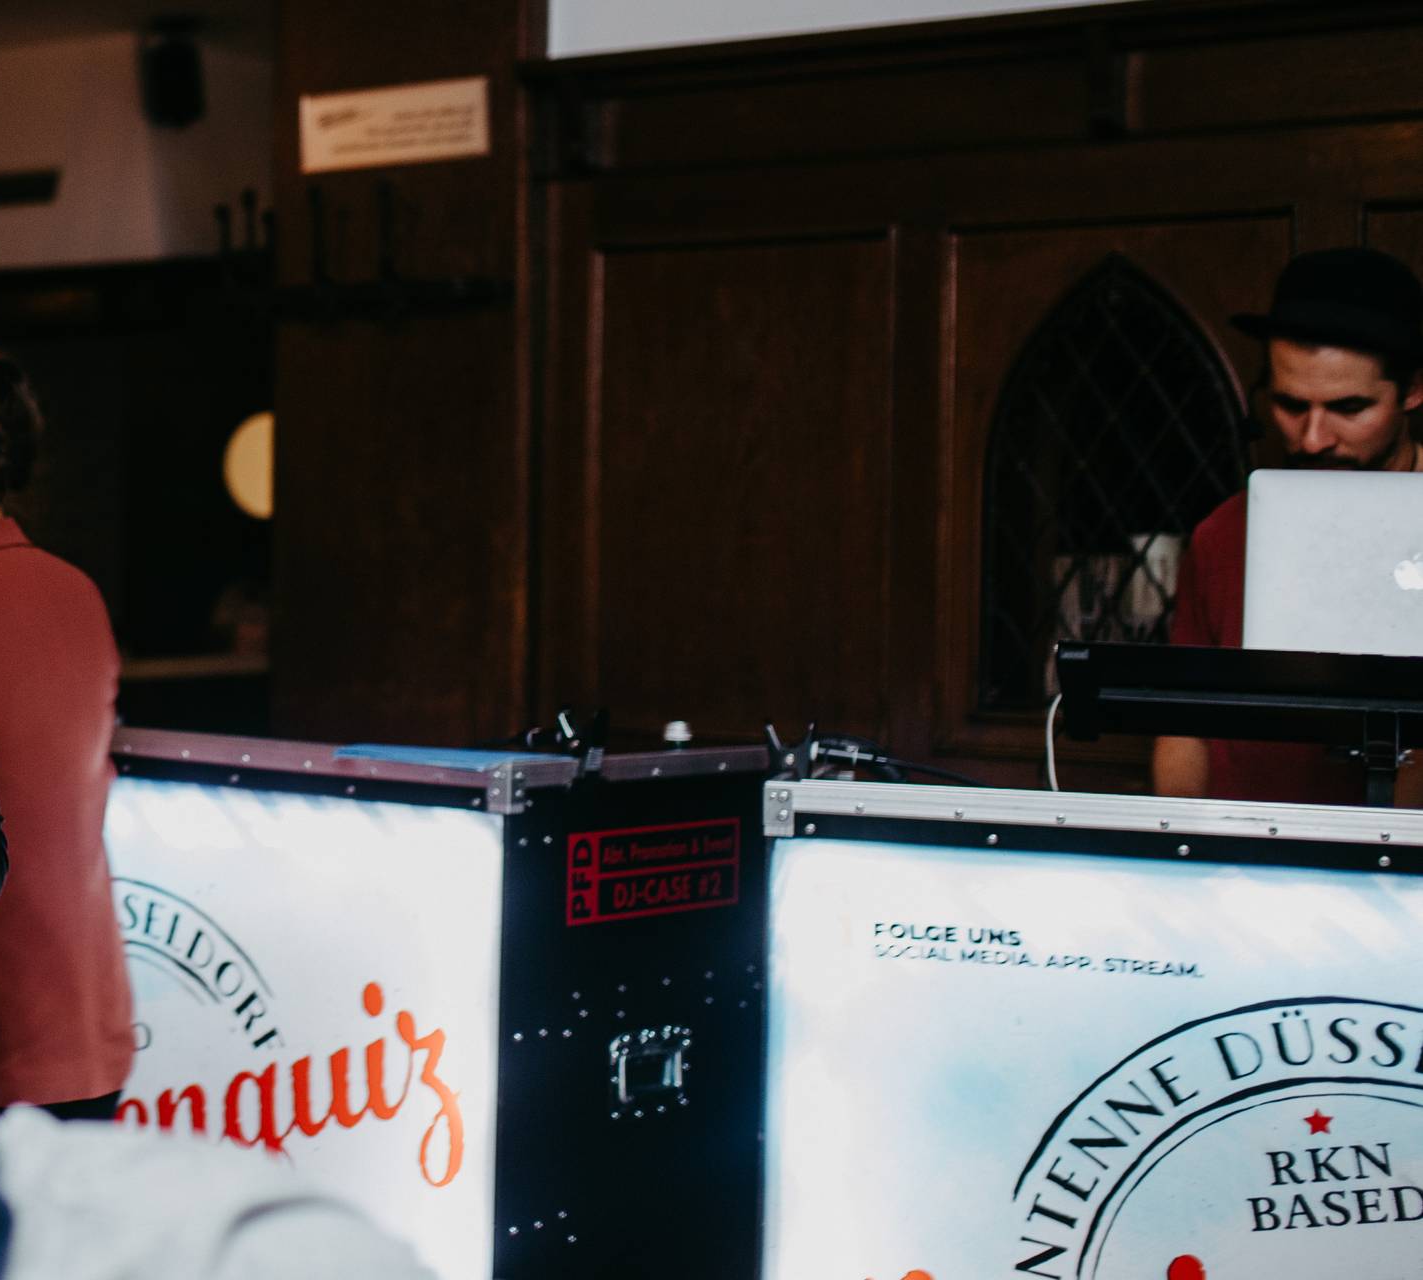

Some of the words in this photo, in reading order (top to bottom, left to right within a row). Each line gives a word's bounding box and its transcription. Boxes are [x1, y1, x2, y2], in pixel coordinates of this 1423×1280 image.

[612, 873, 691, 910] DJ-CASE
[874, 923, 958, 943] FOLGE
[968, 927, 1021, 946] UNS
[874, 943, 953, 962] SOCIAL
[1014, 1055, 1201, 1280] NTENNE
[1214, 1009, 1423, 1081] DÜSS
[1265, 1142, 1392, 1186] RKN
[1246, 1185, 1423, 1232] BASED
